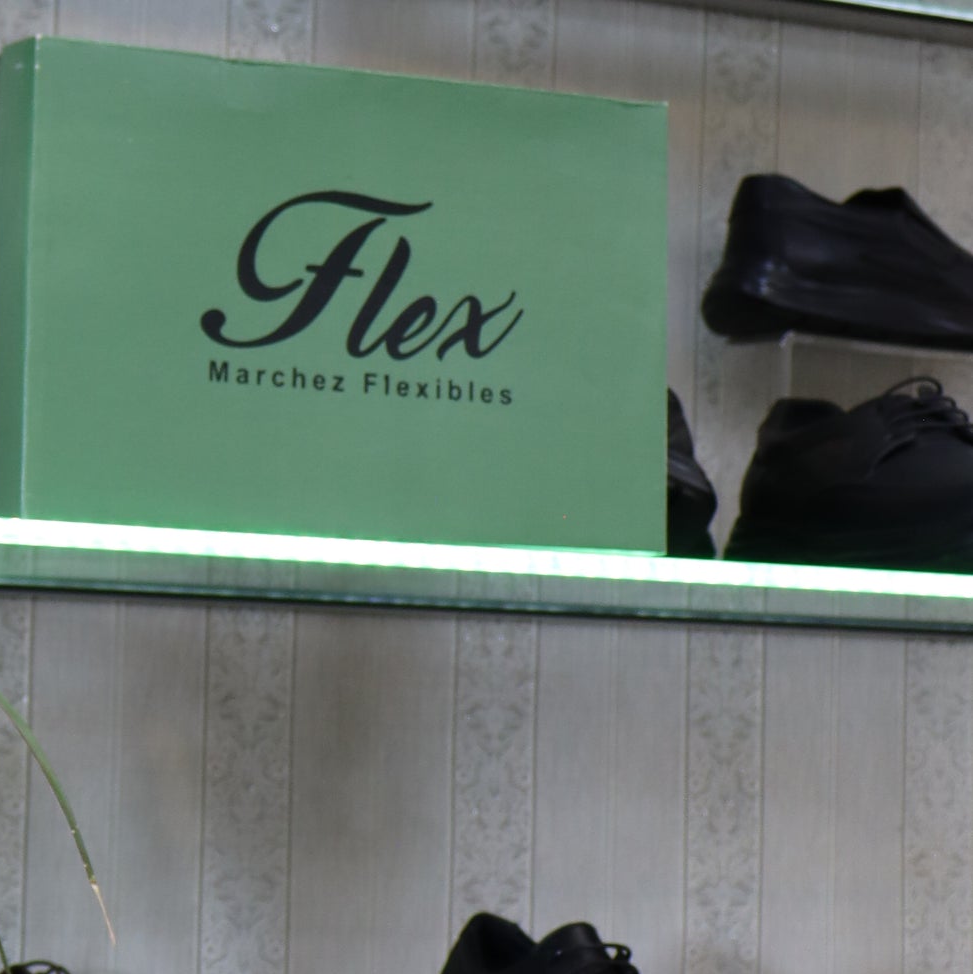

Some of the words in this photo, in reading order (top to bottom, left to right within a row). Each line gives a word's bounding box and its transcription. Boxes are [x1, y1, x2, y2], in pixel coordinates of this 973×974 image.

[200, 190, 524, 361] Flex
[209, 360, 345, 393] Marchez
[364, 372, 513, 405] Flexibles
